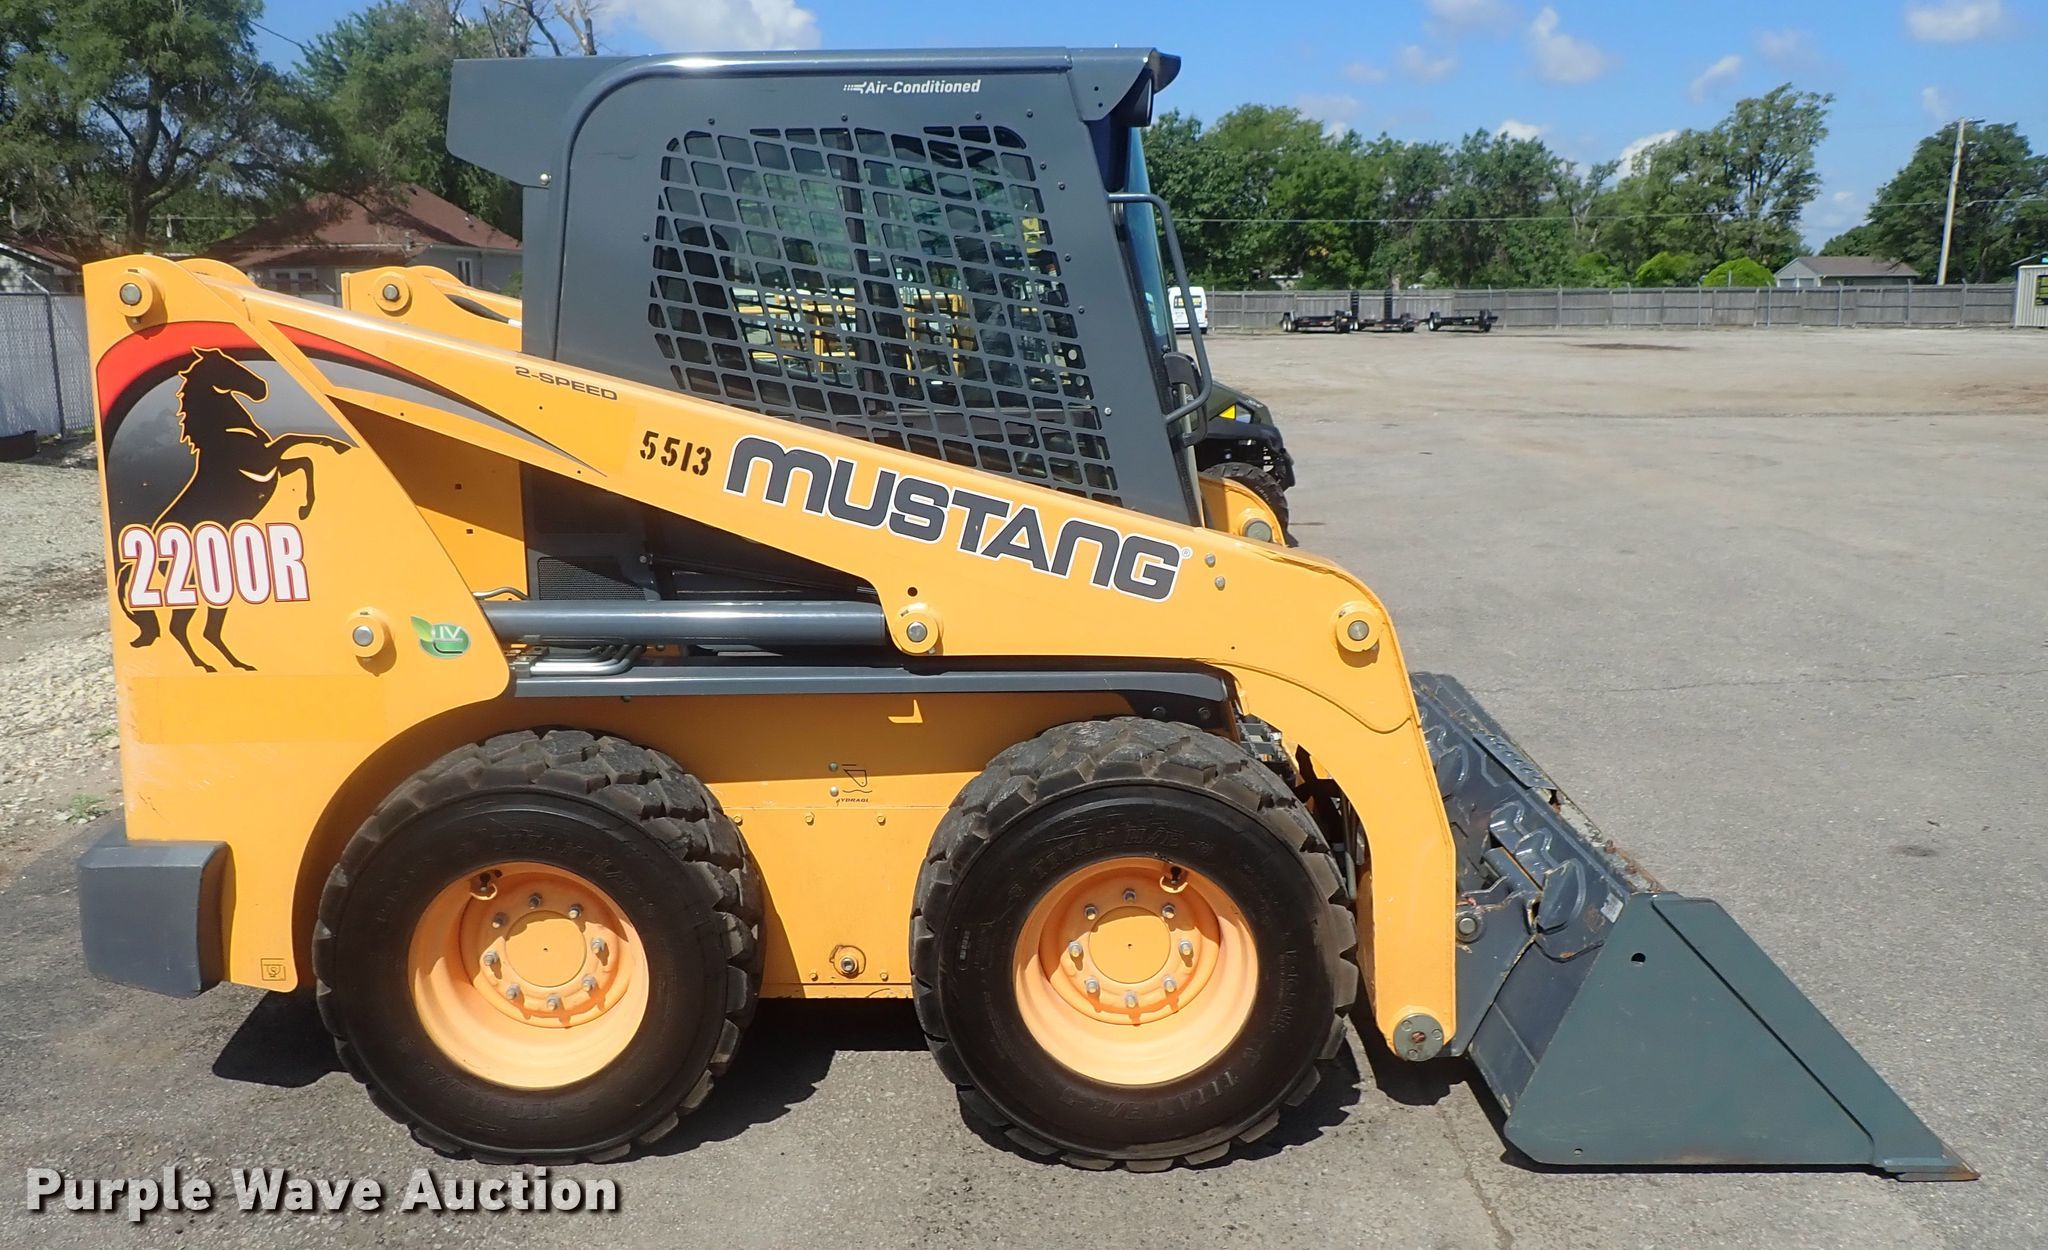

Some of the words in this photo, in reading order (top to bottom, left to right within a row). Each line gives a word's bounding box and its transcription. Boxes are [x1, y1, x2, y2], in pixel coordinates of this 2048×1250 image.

[864, 79, 982, 94] Air-Conditioned
[514, 365, 618, 401] 2-SPEED
[639, 430, 712, 476] 5513
[724, 435, 1181, 602] MUSTANG
[120, 522, 311, 608] 2200R
